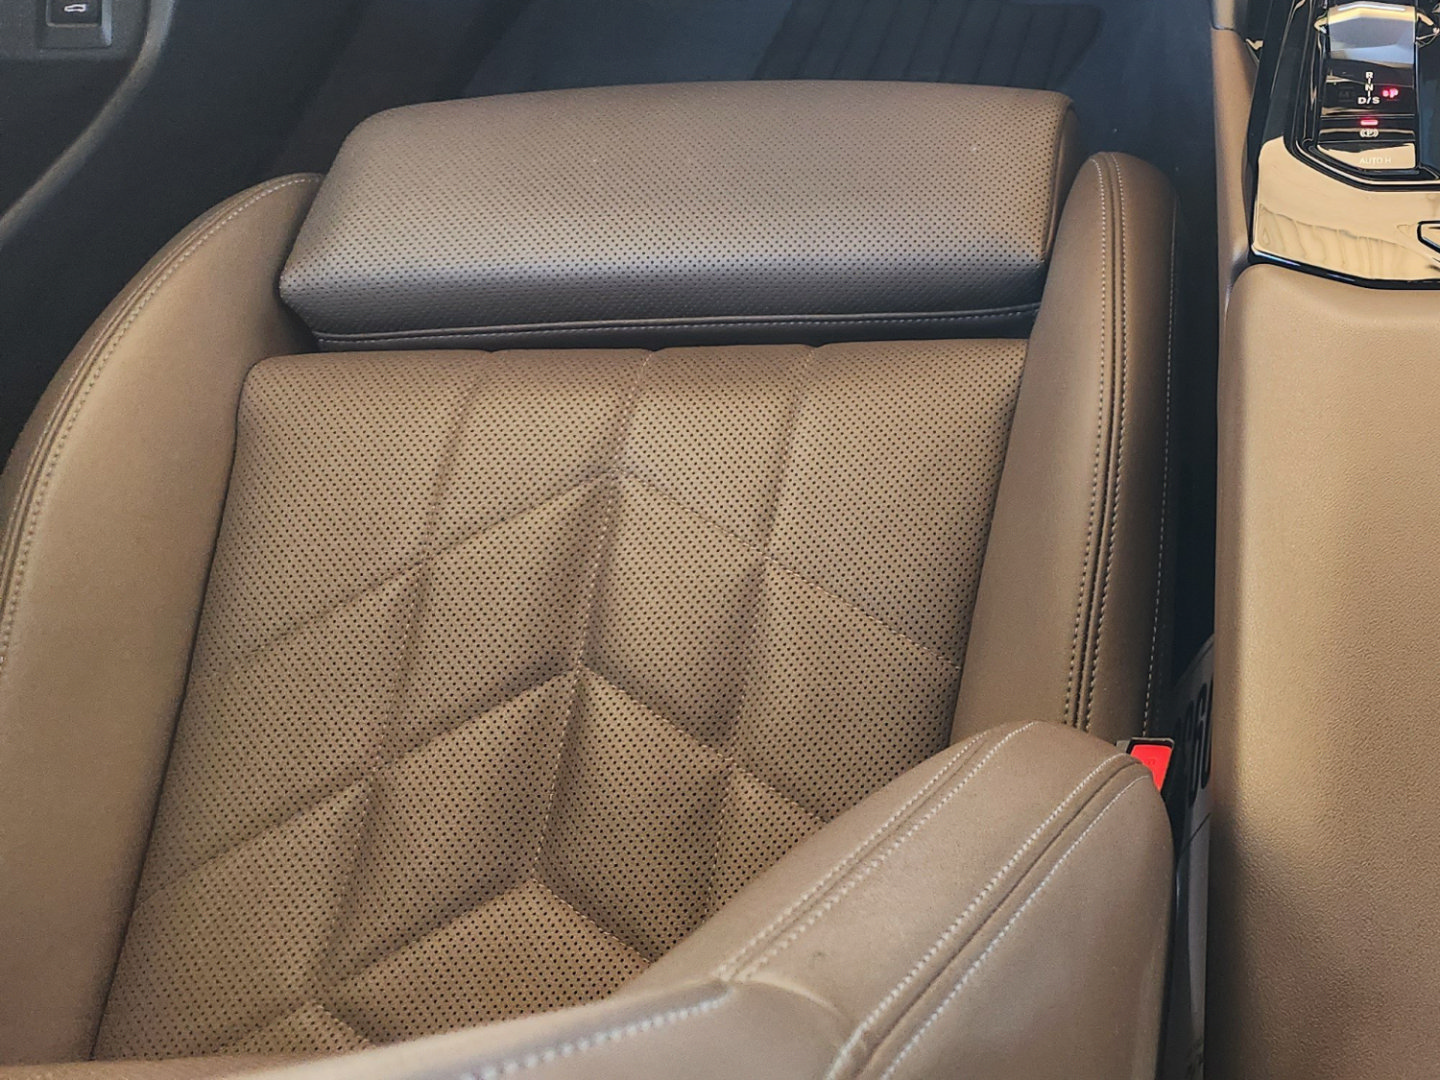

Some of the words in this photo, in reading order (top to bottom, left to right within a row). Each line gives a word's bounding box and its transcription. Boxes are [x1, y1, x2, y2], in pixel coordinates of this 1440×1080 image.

[1365, 71, 1374, 79] R
[1365, 83, 1374, 91] N
[1359, 156, 1384, 165] AUTO
[1384, 156, 1392, 164] H
